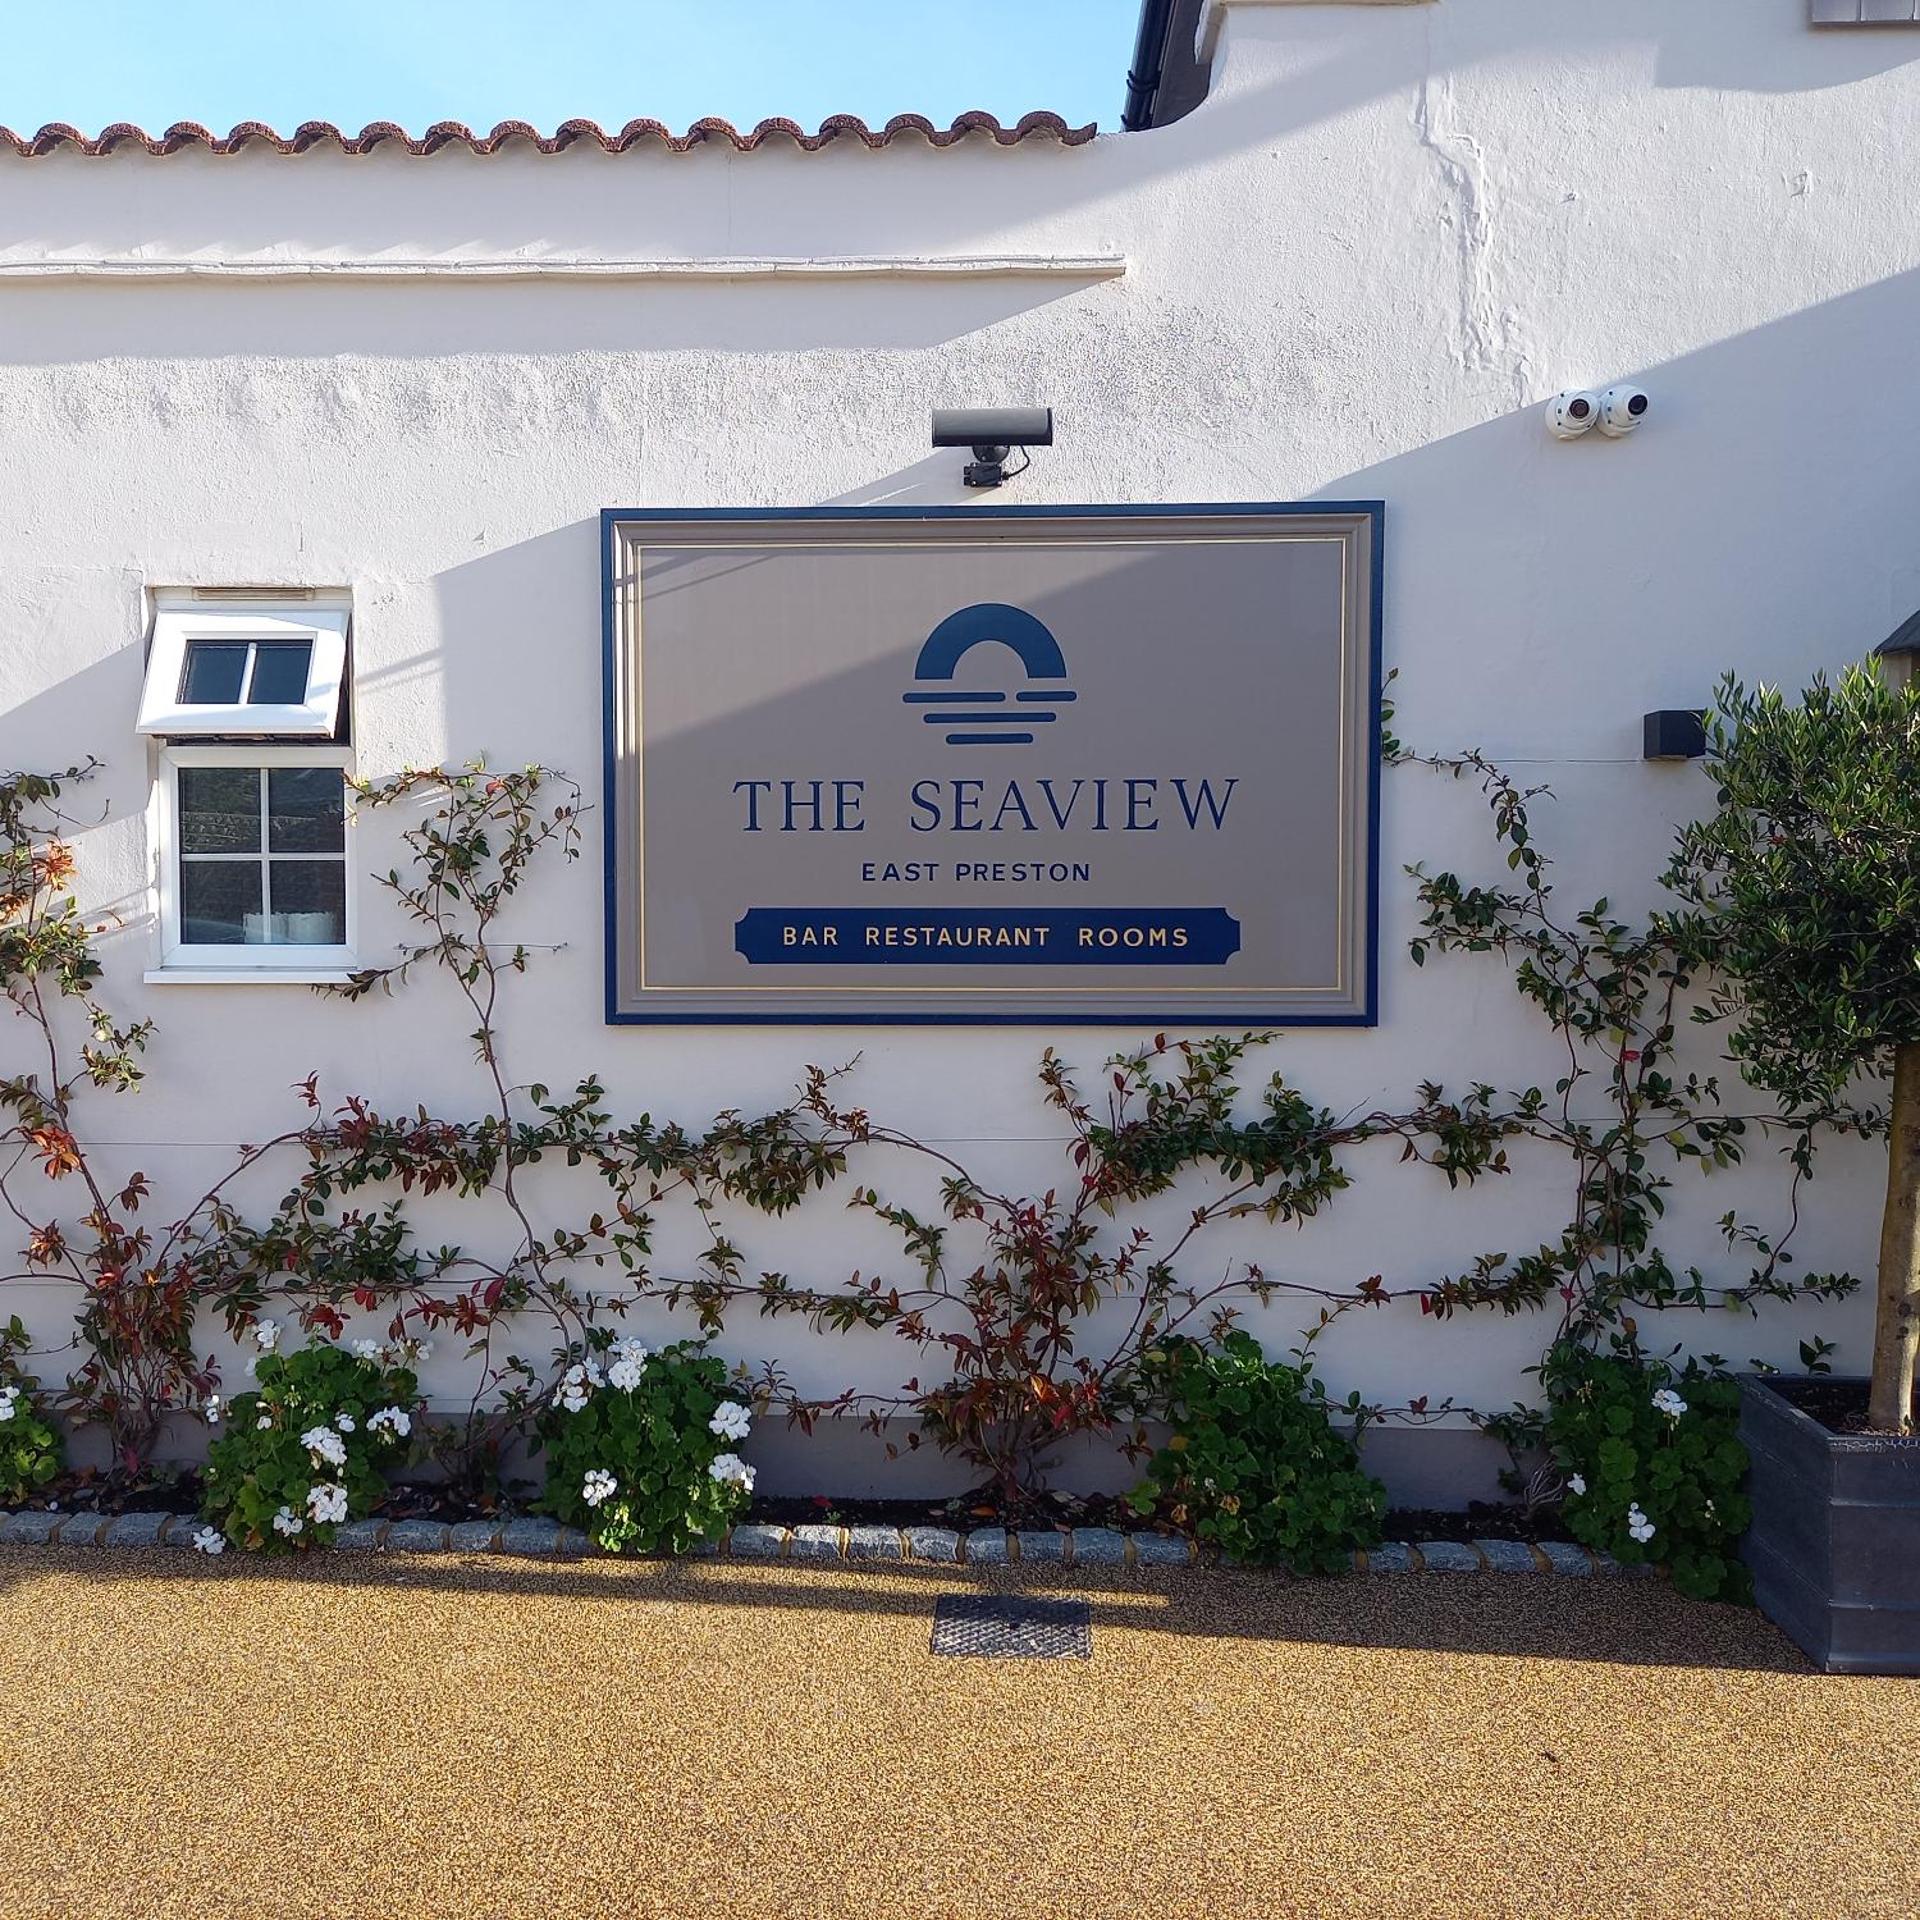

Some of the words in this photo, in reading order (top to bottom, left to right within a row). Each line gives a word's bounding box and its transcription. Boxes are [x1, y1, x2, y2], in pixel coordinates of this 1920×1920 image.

[733, 780, 865, 832] THE
[910, 778, 1240, 832] SEAVIEW
[862, 862, 940, 882] EAST
[955, 862, 1091, 882] PRESTON
[783, 927, 838, 946] BAR
[865, 927, 1050, 947] RESTAURANT
[1078, 927, 1189, 948] ROOMS
